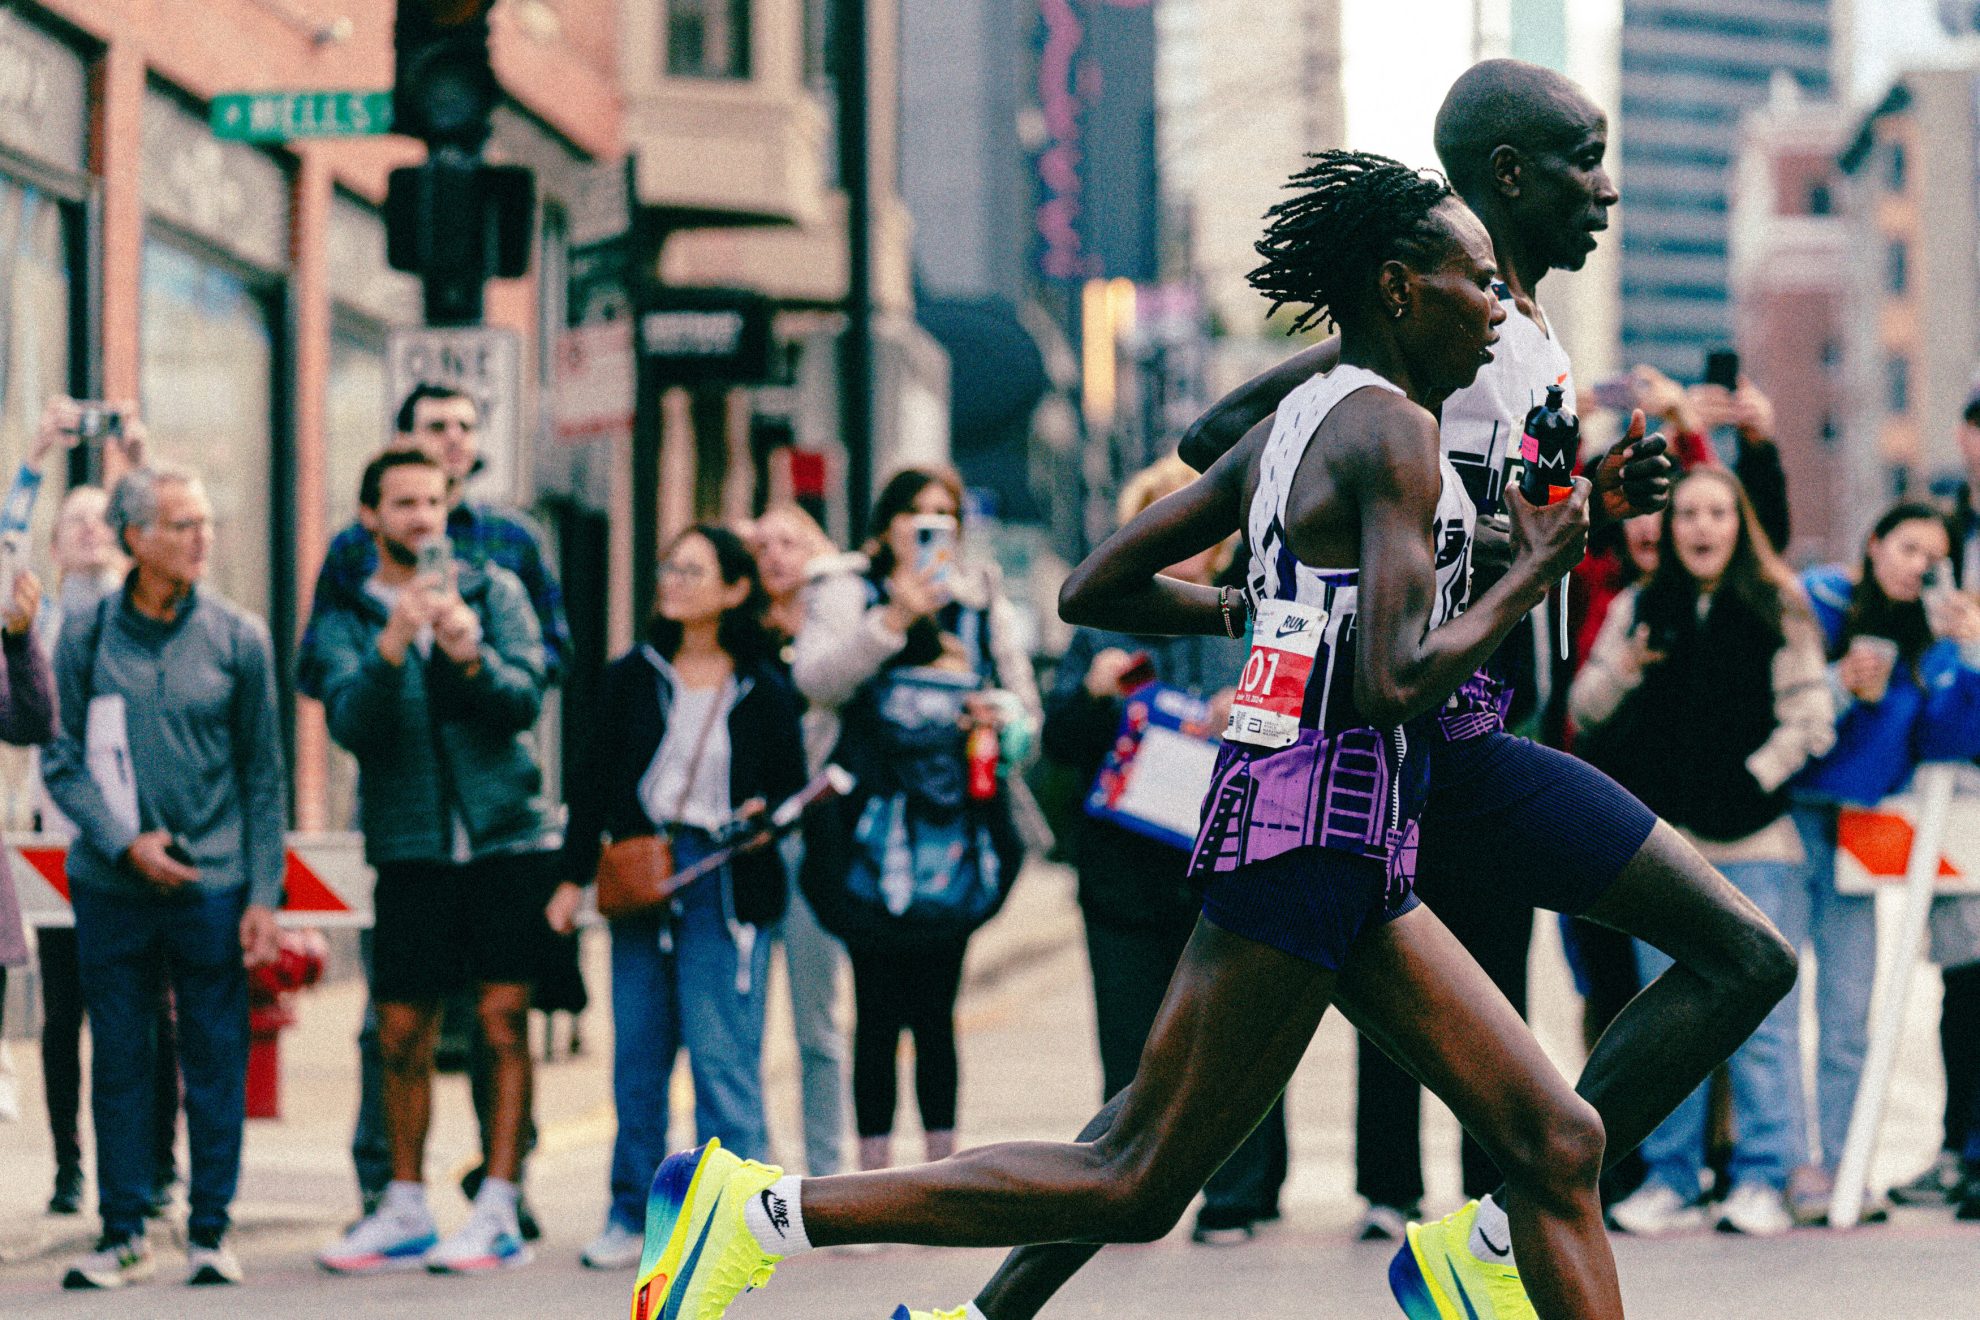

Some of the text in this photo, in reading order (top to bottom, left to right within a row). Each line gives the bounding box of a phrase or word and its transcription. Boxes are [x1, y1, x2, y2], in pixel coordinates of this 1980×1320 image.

[250, 95, 371, 134] WELLS
[404, 343, 488, 379] ONE
[1282, 615, 1309, 631] RUN
[773, 1197, 790, 1228] NIKE
